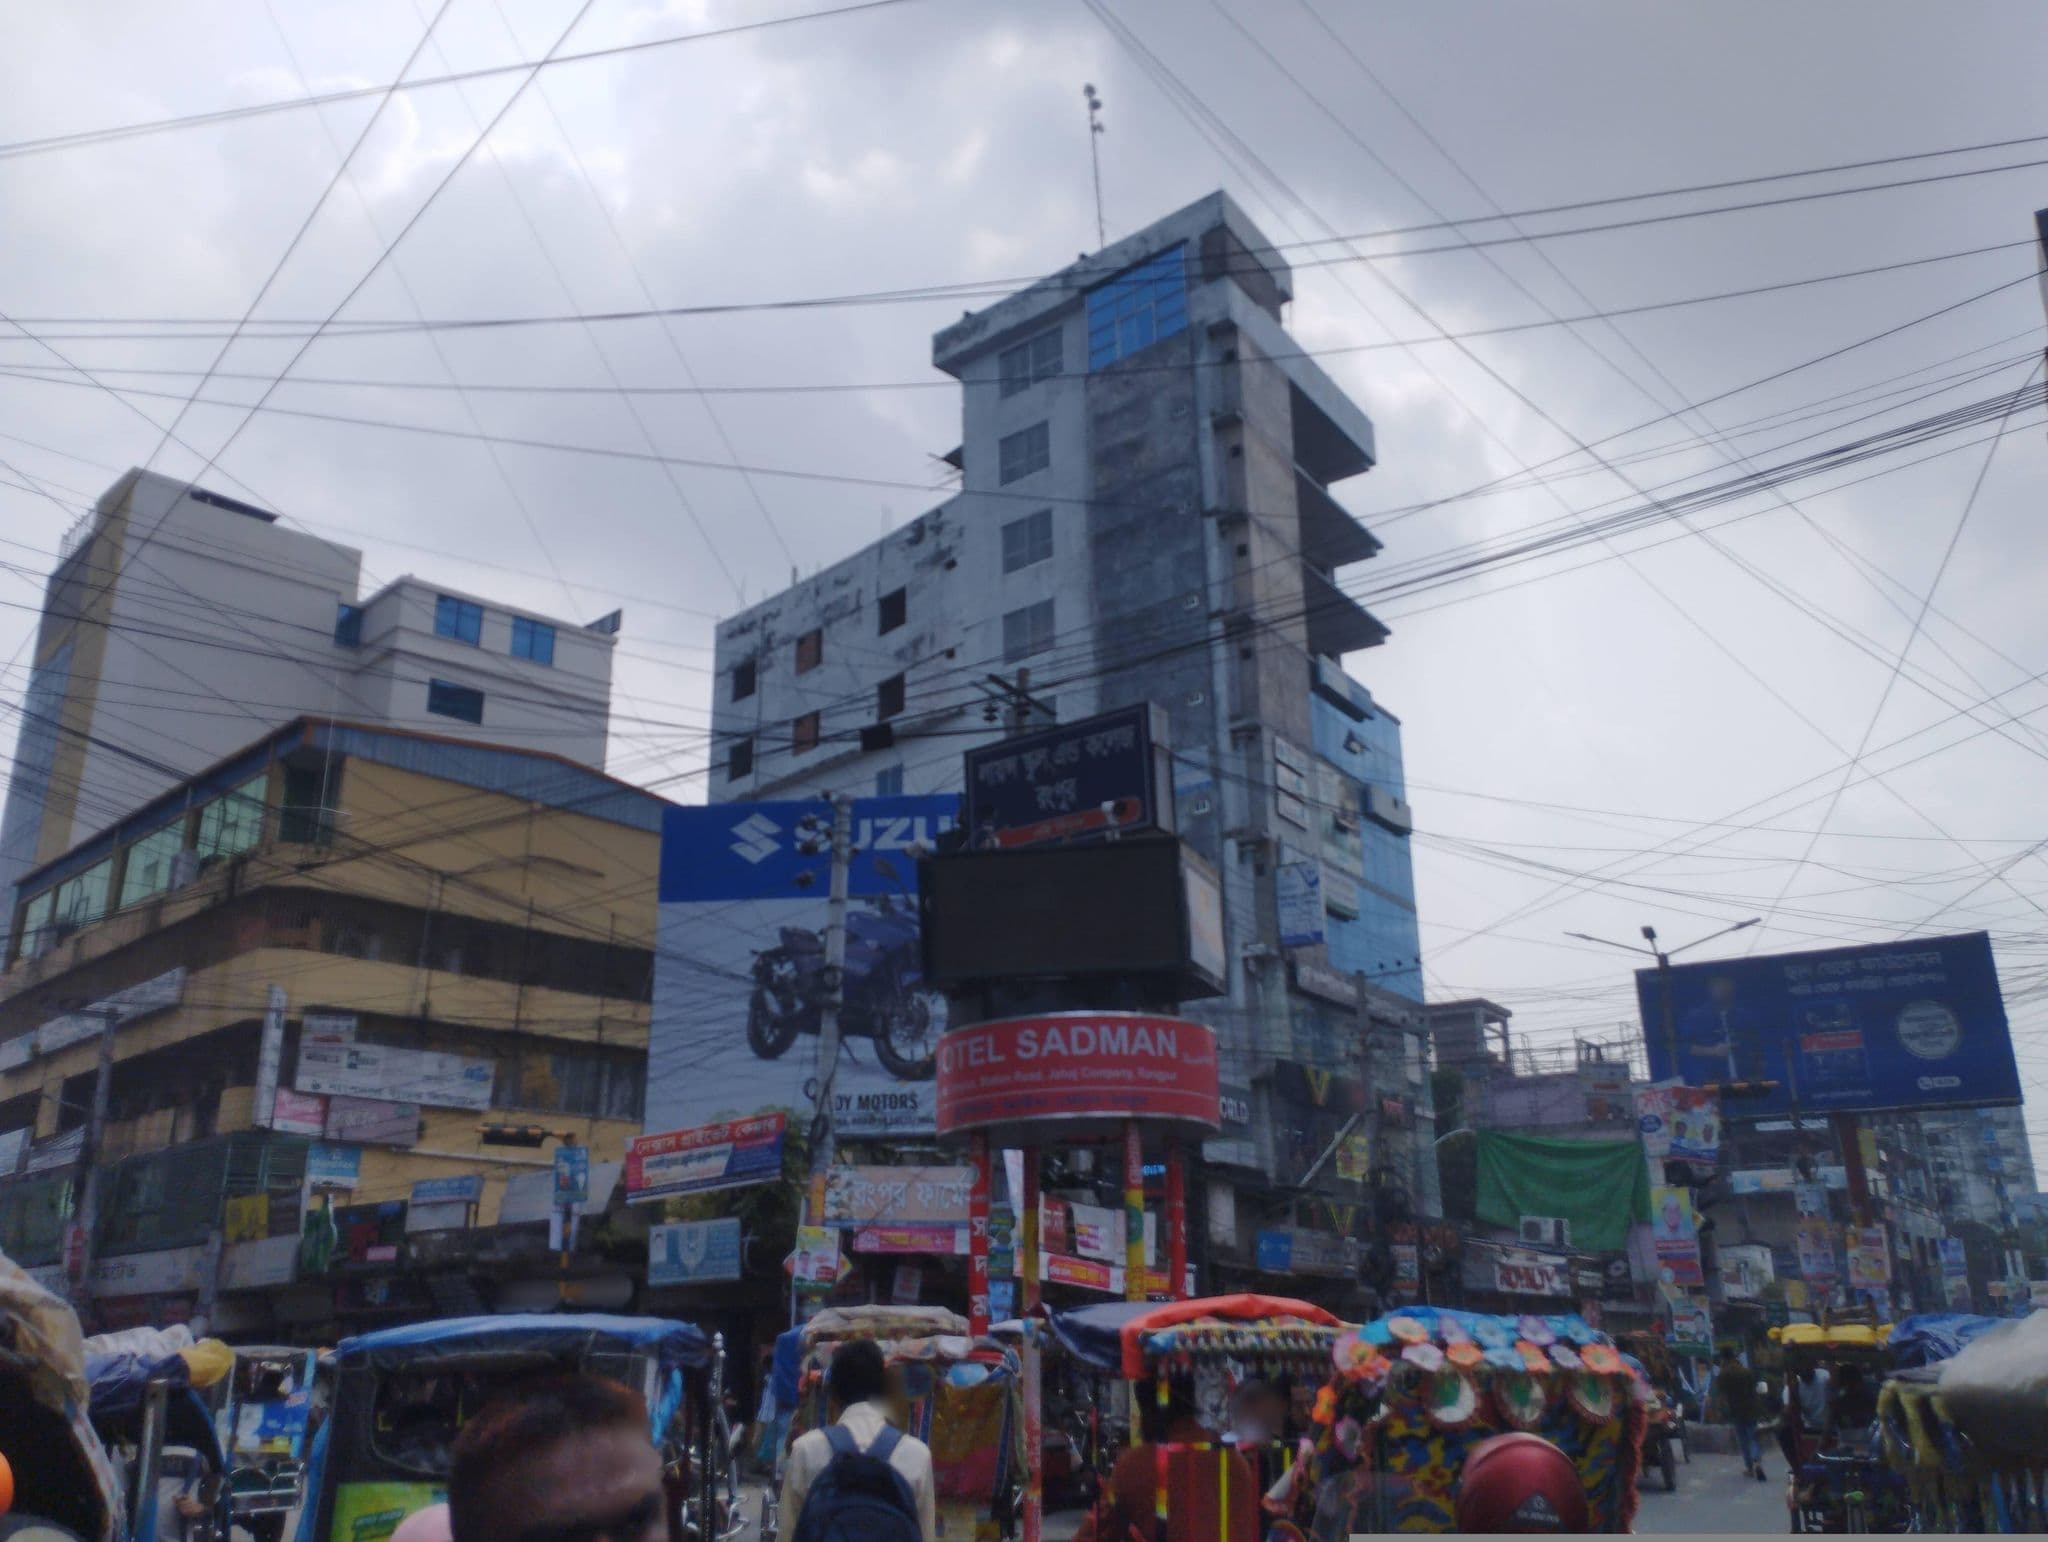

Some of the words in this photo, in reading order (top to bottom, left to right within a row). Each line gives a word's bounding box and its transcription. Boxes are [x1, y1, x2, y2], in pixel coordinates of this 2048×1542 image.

[793, 815, 958, 852] SUZU
[1016, 1025, 1178, 1059] SADMAN
[858, 1092, 918, 1112] MOTORS
[853, 1180, 907, 1217] রংপুর
